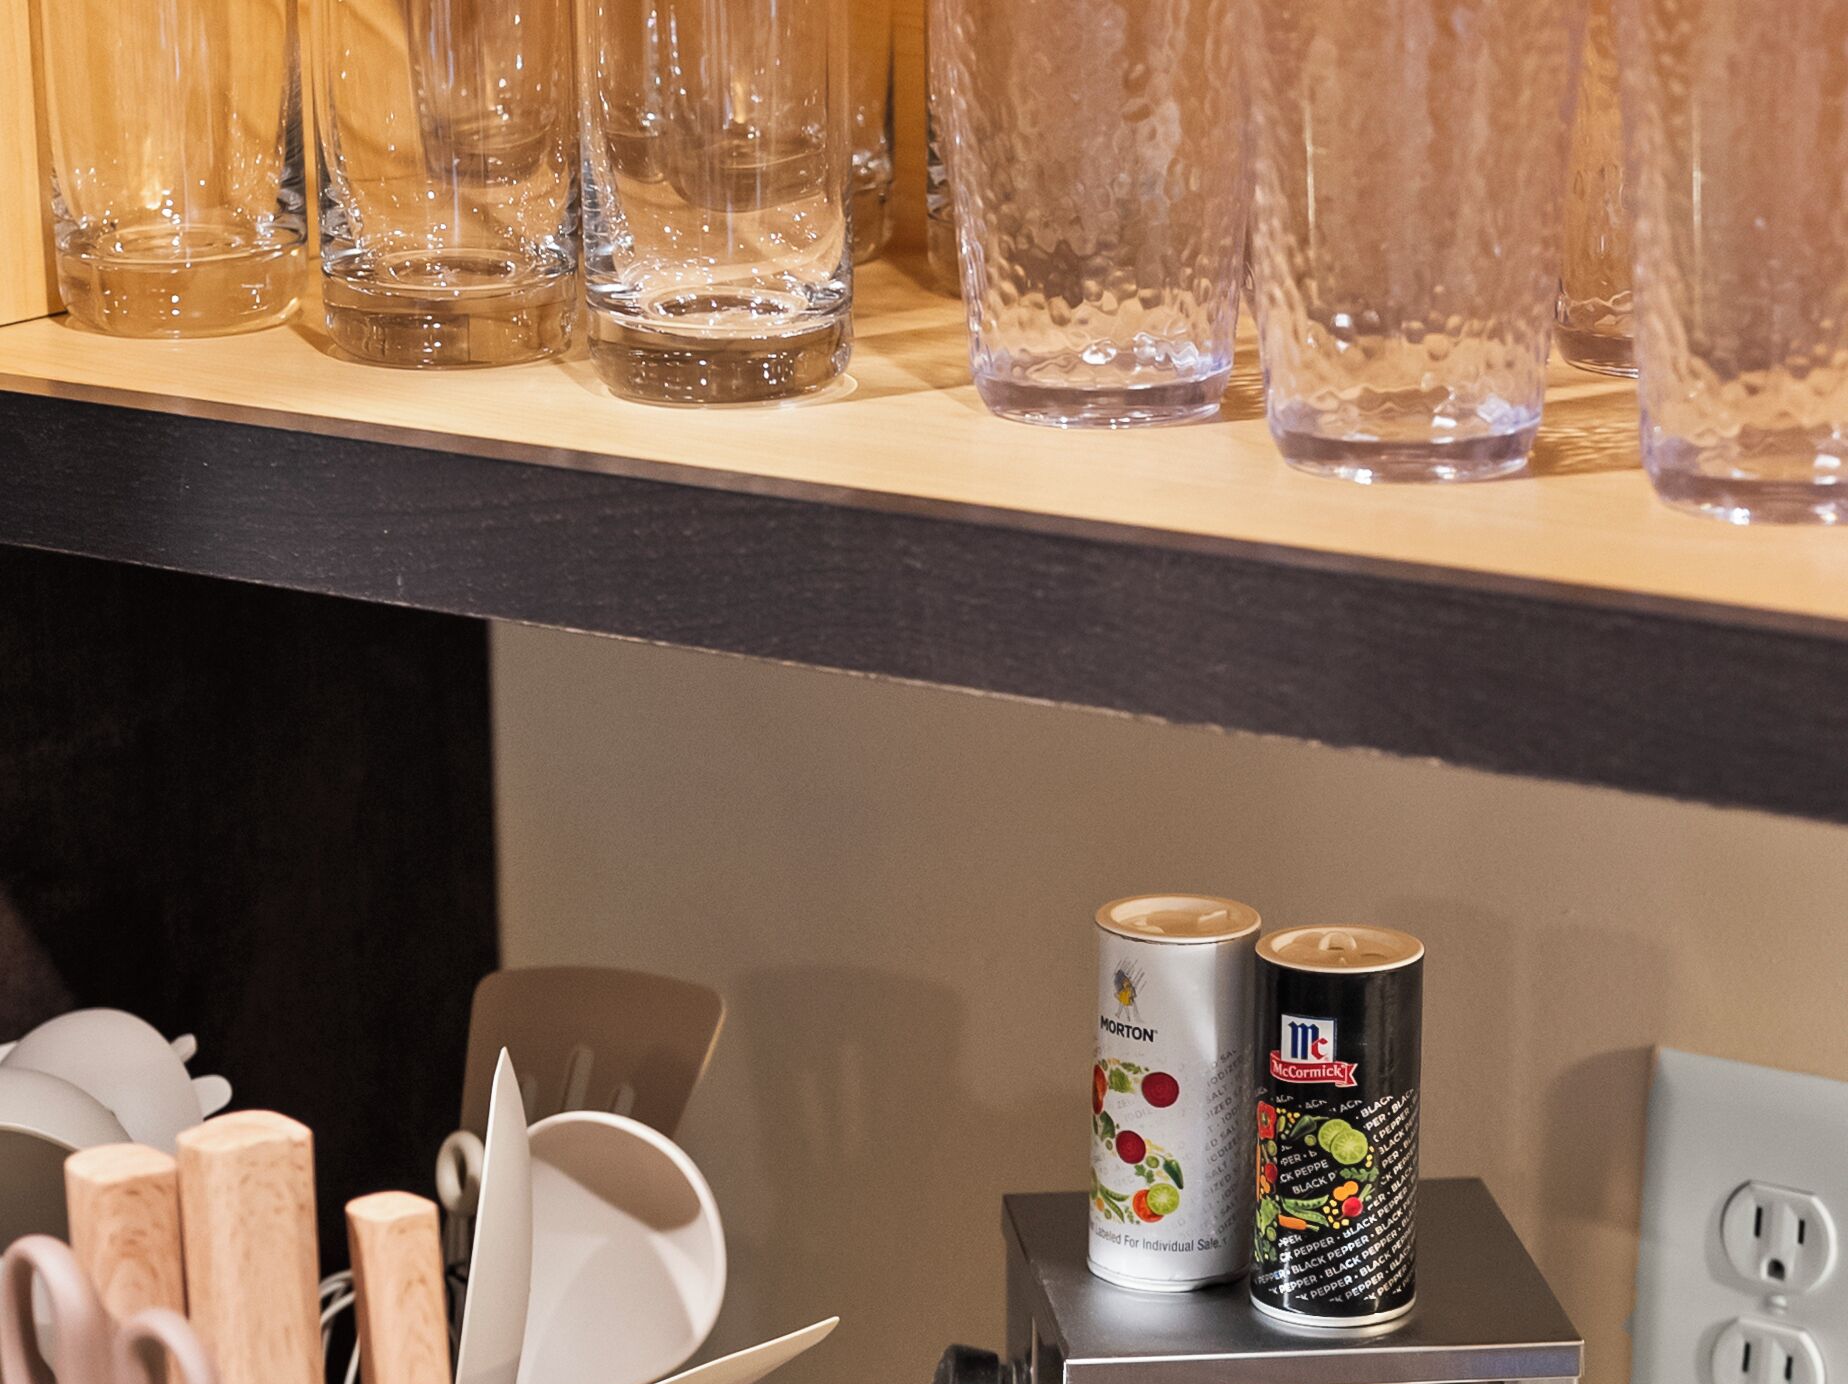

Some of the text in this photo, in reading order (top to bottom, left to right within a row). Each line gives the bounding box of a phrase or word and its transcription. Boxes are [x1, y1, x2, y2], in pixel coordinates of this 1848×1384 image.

[1100, 1016, 1154, 1042] MORTON
[1272, 1060, 1344, 1079] McCormick
[1292, 1176, 1328, 1195] BLACK
[1124, 1235, 1139, 1248] For
[1142, 1238, 1194, 1252] Individual
[1291, 1255, 1327, 1275] BLACK
[1327, 1235, 1369, 1261] PEPPER
[1374, 1207, 1404, 1236] BLACK
[1293, 1236, 1335, 1258] PEPPER
[1342, 1213, 1378, 1238] BLACK
[1279, 1275, 1318, 1294] PEPPER
[1324, 1255, 1362, 1278] BLACK
[1361, 1229, 1398, 1260] PEPPER
[1310, 1275, 1353, 1299] PEPPER
[1359, 1249, 1391, 1277] BLACK
[1345, 1271, 1385, 1300] PEPPER
